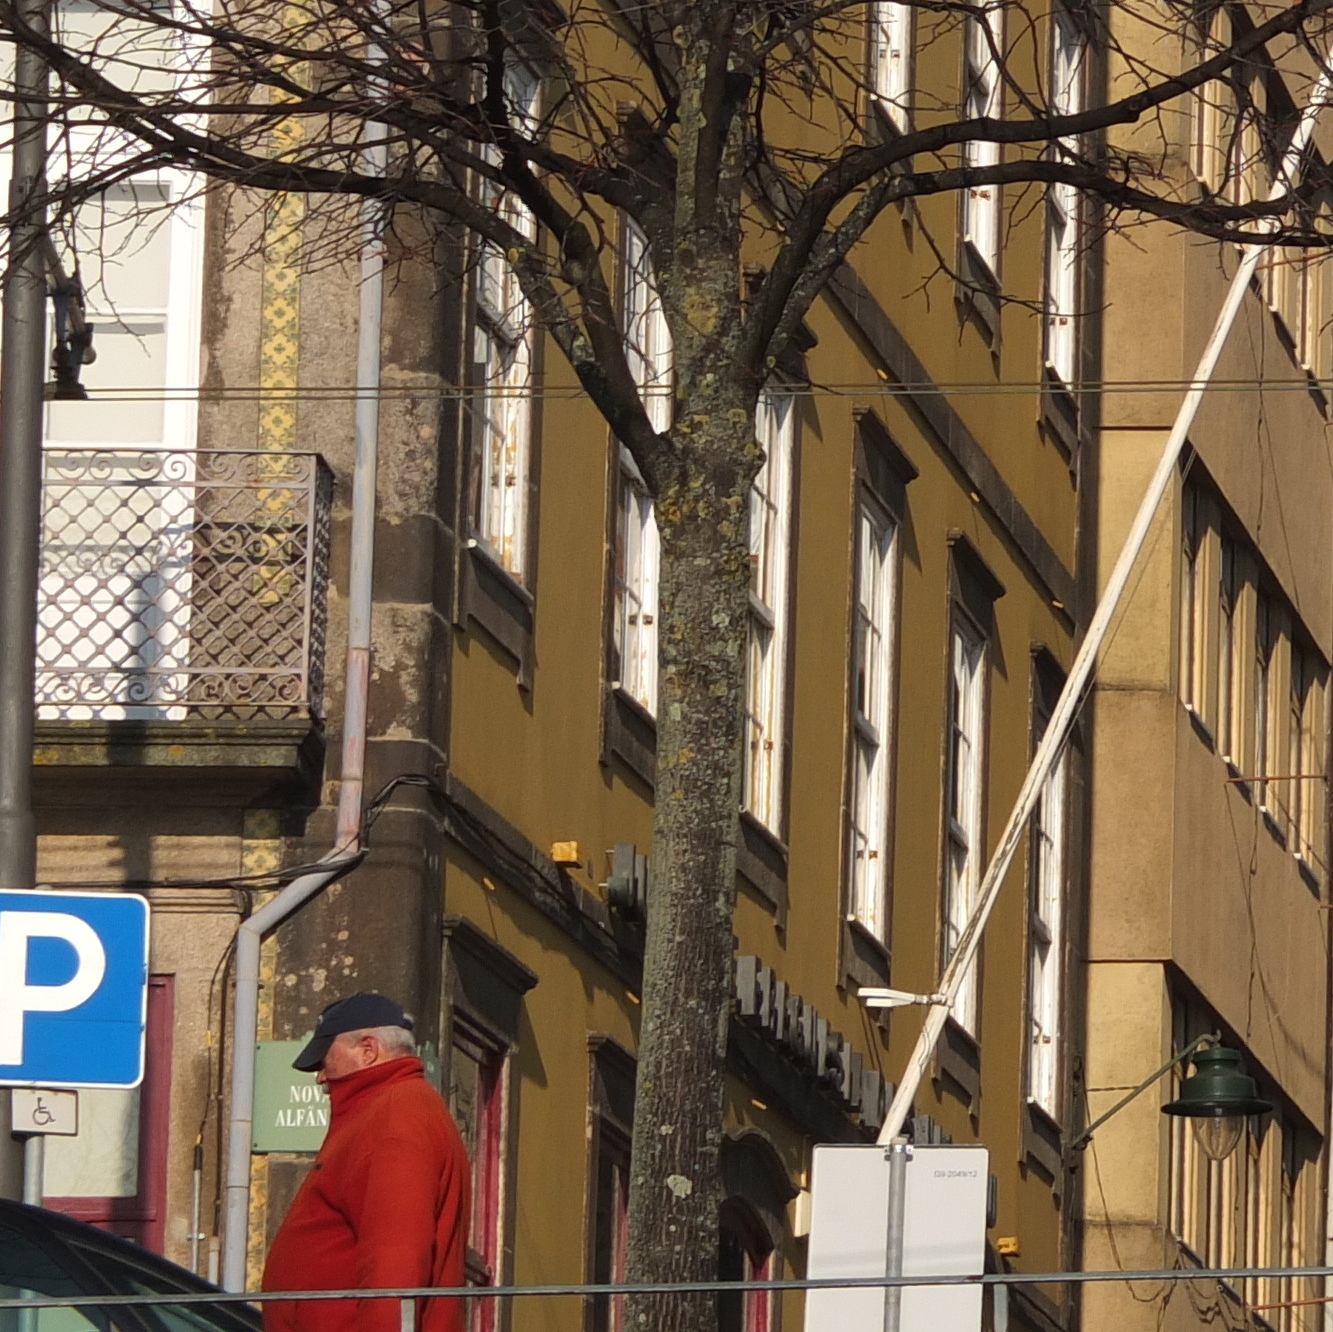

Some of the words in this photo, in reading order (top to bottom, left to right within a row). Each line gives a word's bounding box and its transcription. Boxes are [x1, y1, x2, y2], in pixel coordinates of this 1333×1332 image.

[0, 910, 106, 1066] P
[289, 1085, 328, 1103] NOV
[275, 1105, 328, 1127] ALFÂN
